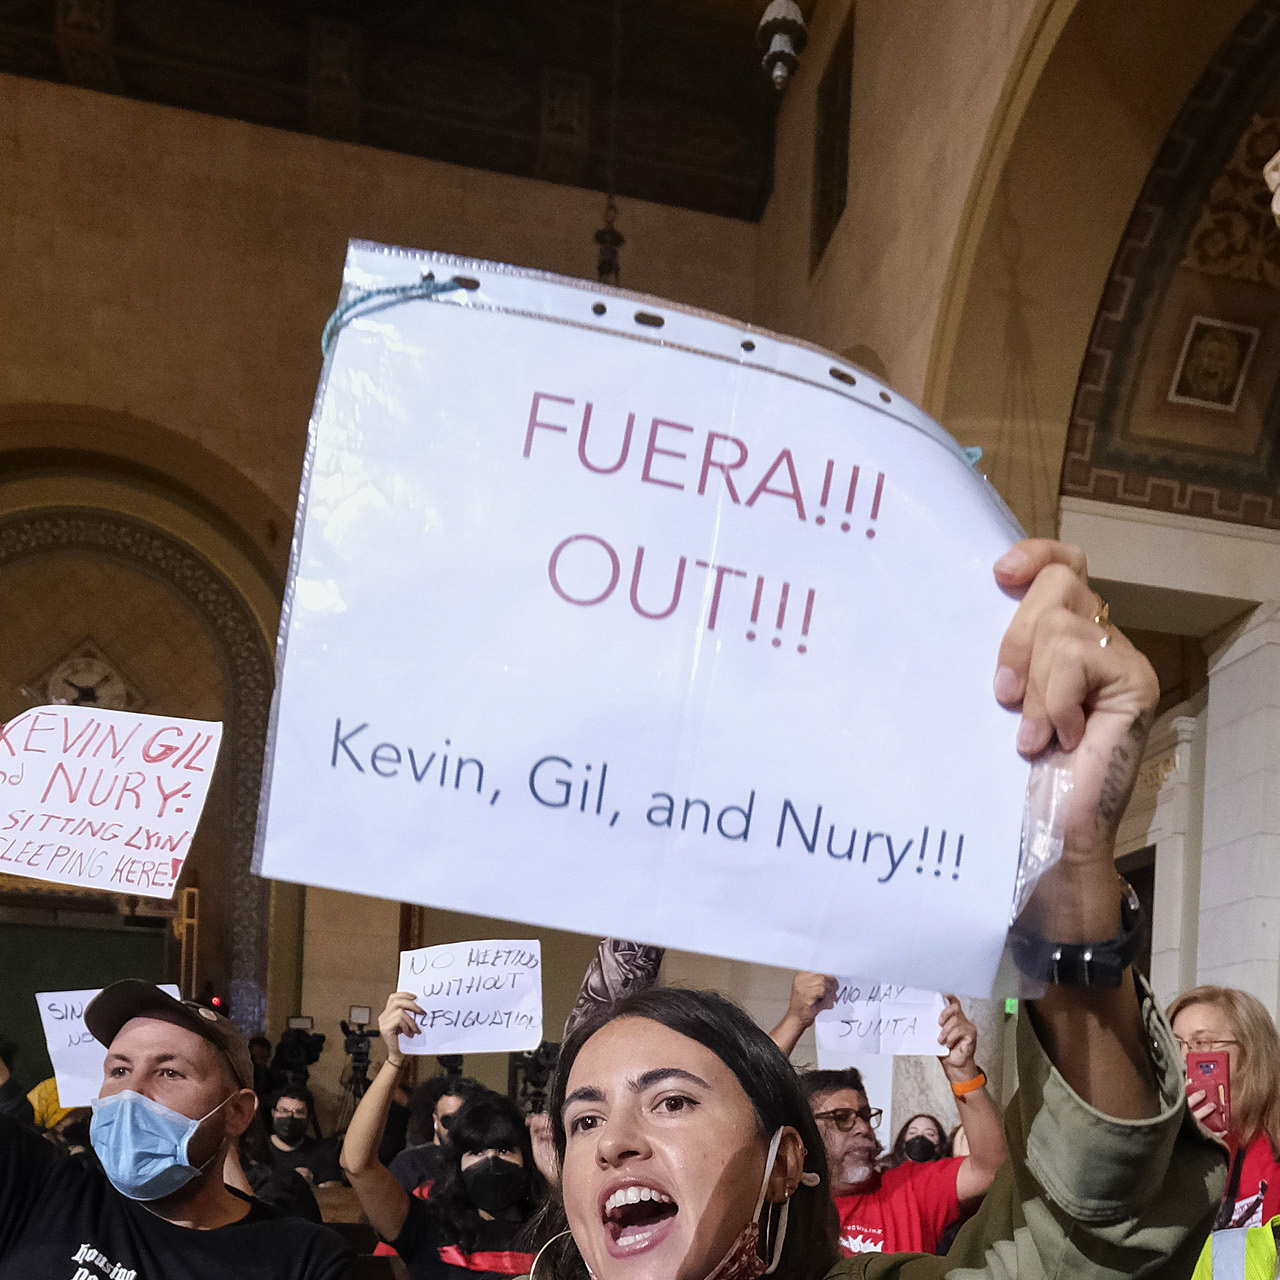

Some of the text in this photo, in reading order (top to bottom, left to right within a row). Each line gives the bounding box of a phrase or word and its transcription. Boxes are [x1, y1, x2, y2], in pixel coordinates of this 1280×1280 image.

[521, 390, 887, 539] FUERA!!!
[547, 534, 816, 655] OUT!!!
[142, 726, 214, 772] GIL
[40, 762, 191, 818] NURY:
[331, 718, 966, 883] Kevin, Gil, and Nury!!!
[3, 810, 123, 840] SITTING
[111, 853, 184, 888] HERE!
[408, 948, 539, 976] NO MEETING
[423, 972, 524, 997] WITHOUT
[835, 984, 906, 1007] NO HAY
[48, 1003, 83, 1021] SIN
[839, 1017, 917, 1037] JUNTA
